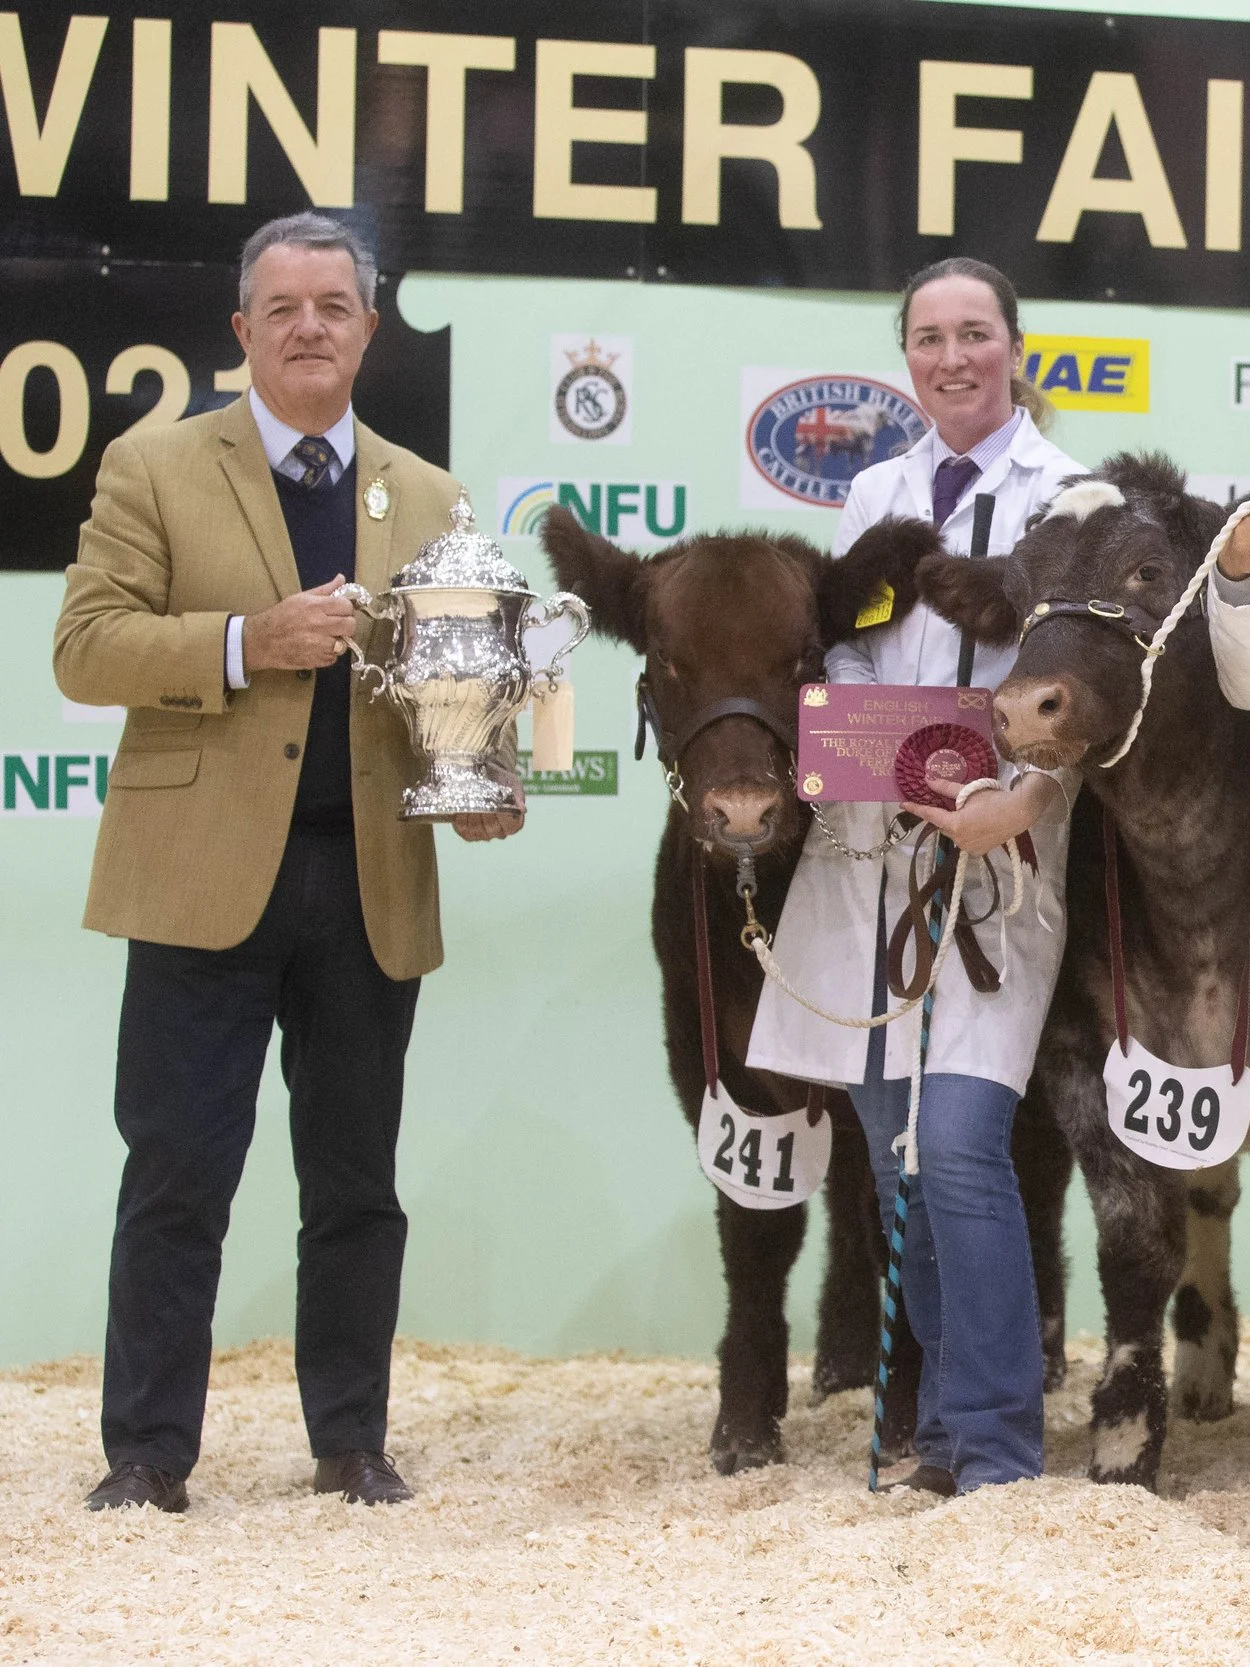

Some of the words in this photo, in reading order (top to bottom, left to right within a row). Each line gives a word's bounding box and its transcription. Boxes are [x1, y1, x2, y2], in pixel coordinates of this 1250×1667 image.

[770, 383, 861, 420] BRITISH
[758, 447, 829, 498] CATTLE
[558, 482, 687, 538] NFU
[847, 712, 907, 726] WINTER
[863, 699, 929, 713] ENGLISH
[821, 737, 846, 748] THE
[836, 747, 871, 758] DUKE
[1123, 1069, 1220, 1151] 239
[712, 1112, 795, 1192] 241
